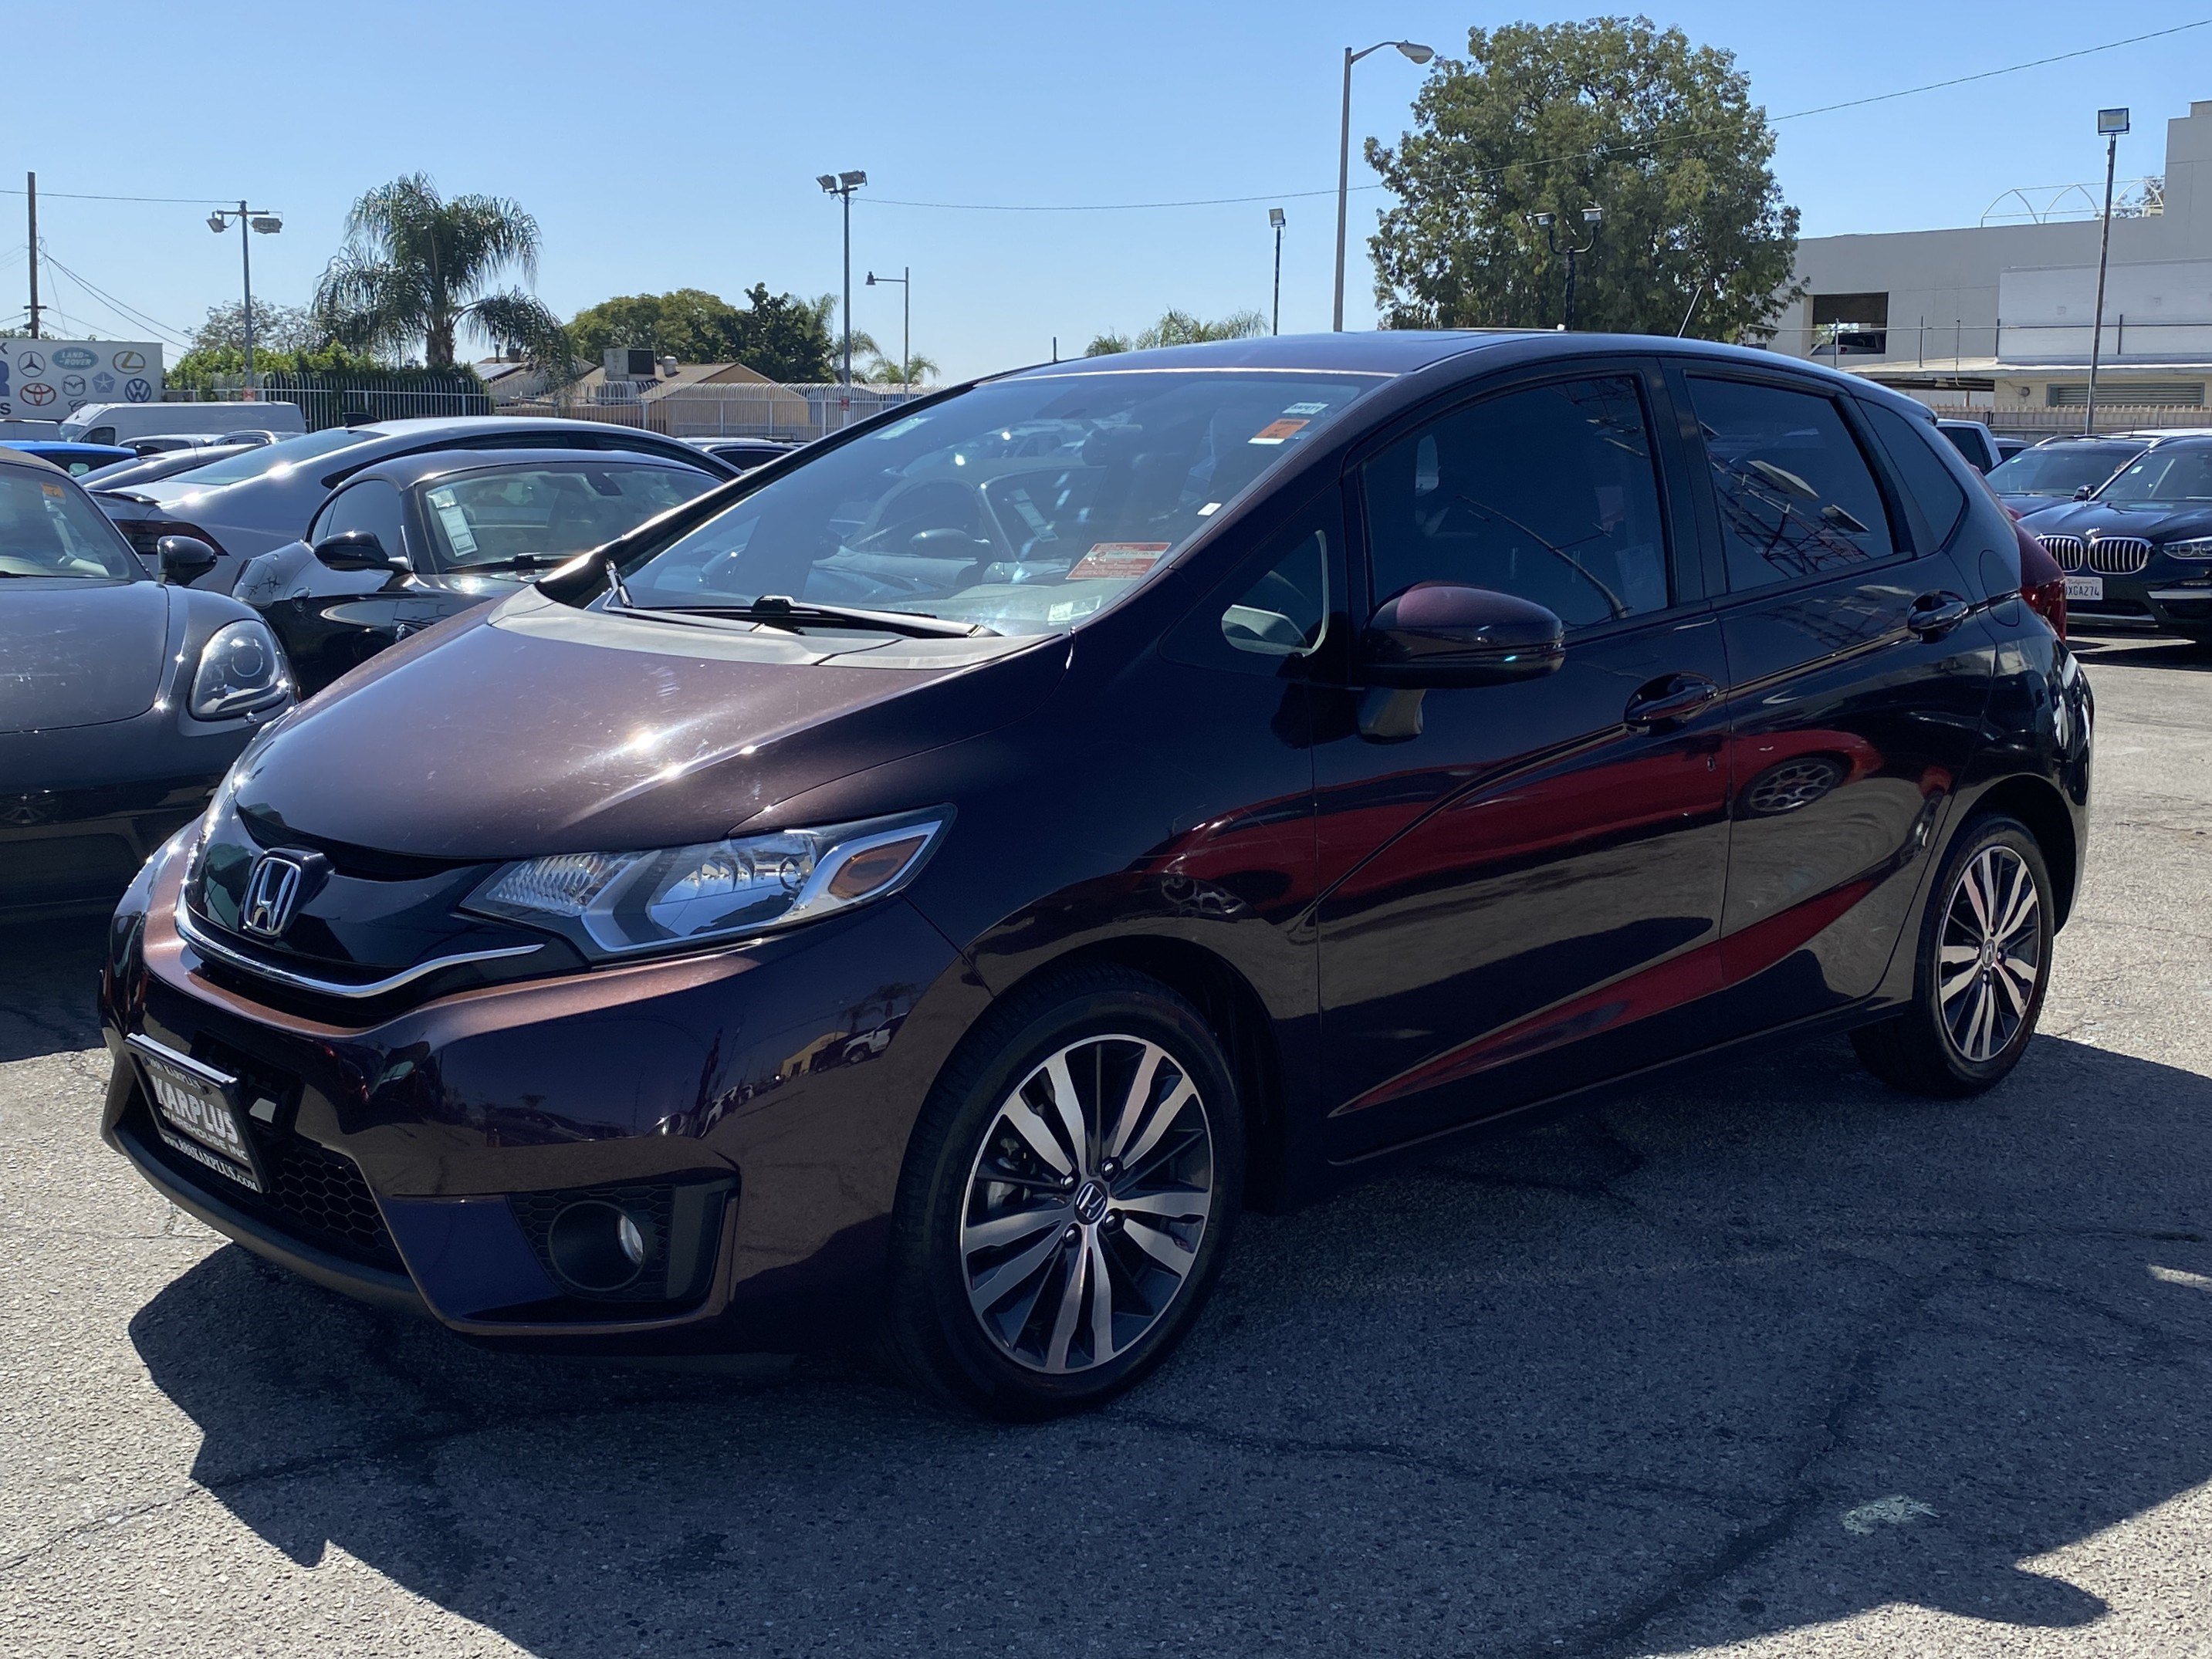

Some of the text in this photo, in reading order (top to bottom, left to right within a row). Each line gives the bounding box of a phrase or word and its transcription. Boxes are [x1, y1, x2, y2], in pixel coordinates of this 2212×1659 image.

[151, 1075, 238, 1144] KARPLUS
[160, 1107, 249, 1161] WAREHOUSE INC
